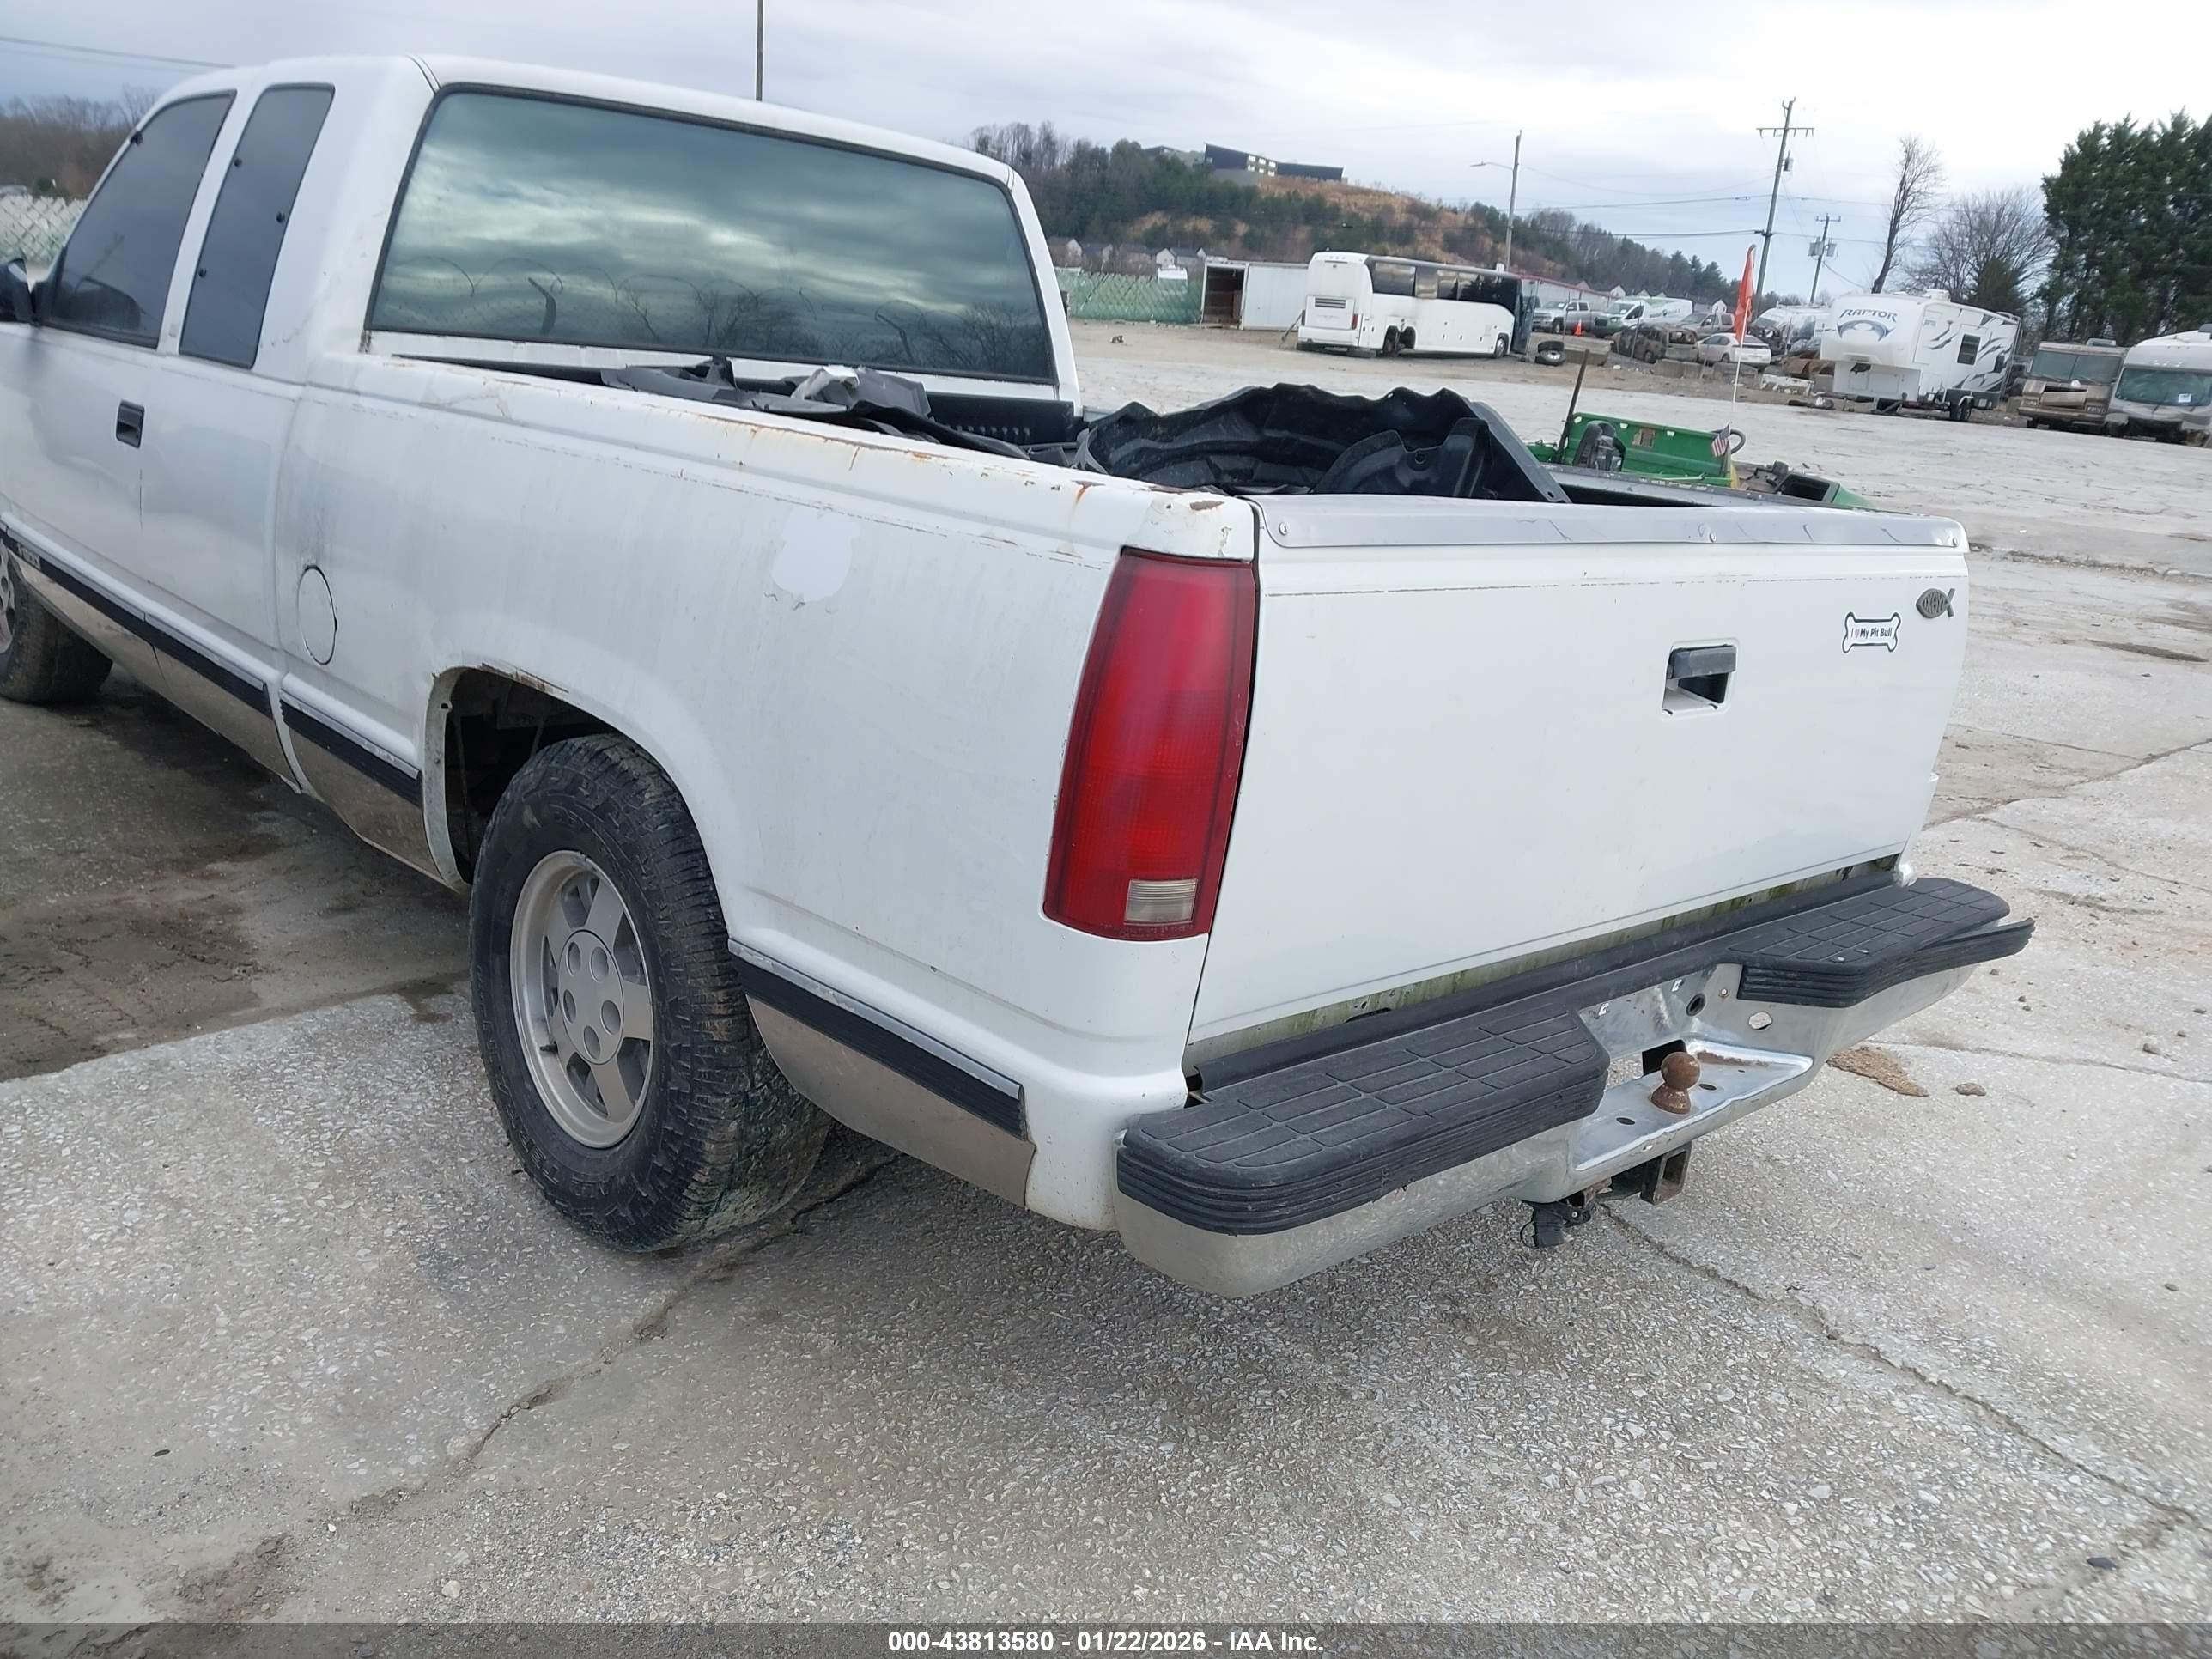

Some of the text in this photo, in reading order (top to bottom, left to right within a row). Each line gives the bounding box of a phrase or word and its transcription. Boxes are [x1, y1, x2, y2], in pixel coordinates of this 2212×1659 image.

[1839, 309, 1897, 322] RAPTOR
[1860, 628, 1869, 639] My
[1870, 627, 1879, 637] Pit
[1881, 628, 1892, 637] Bull
